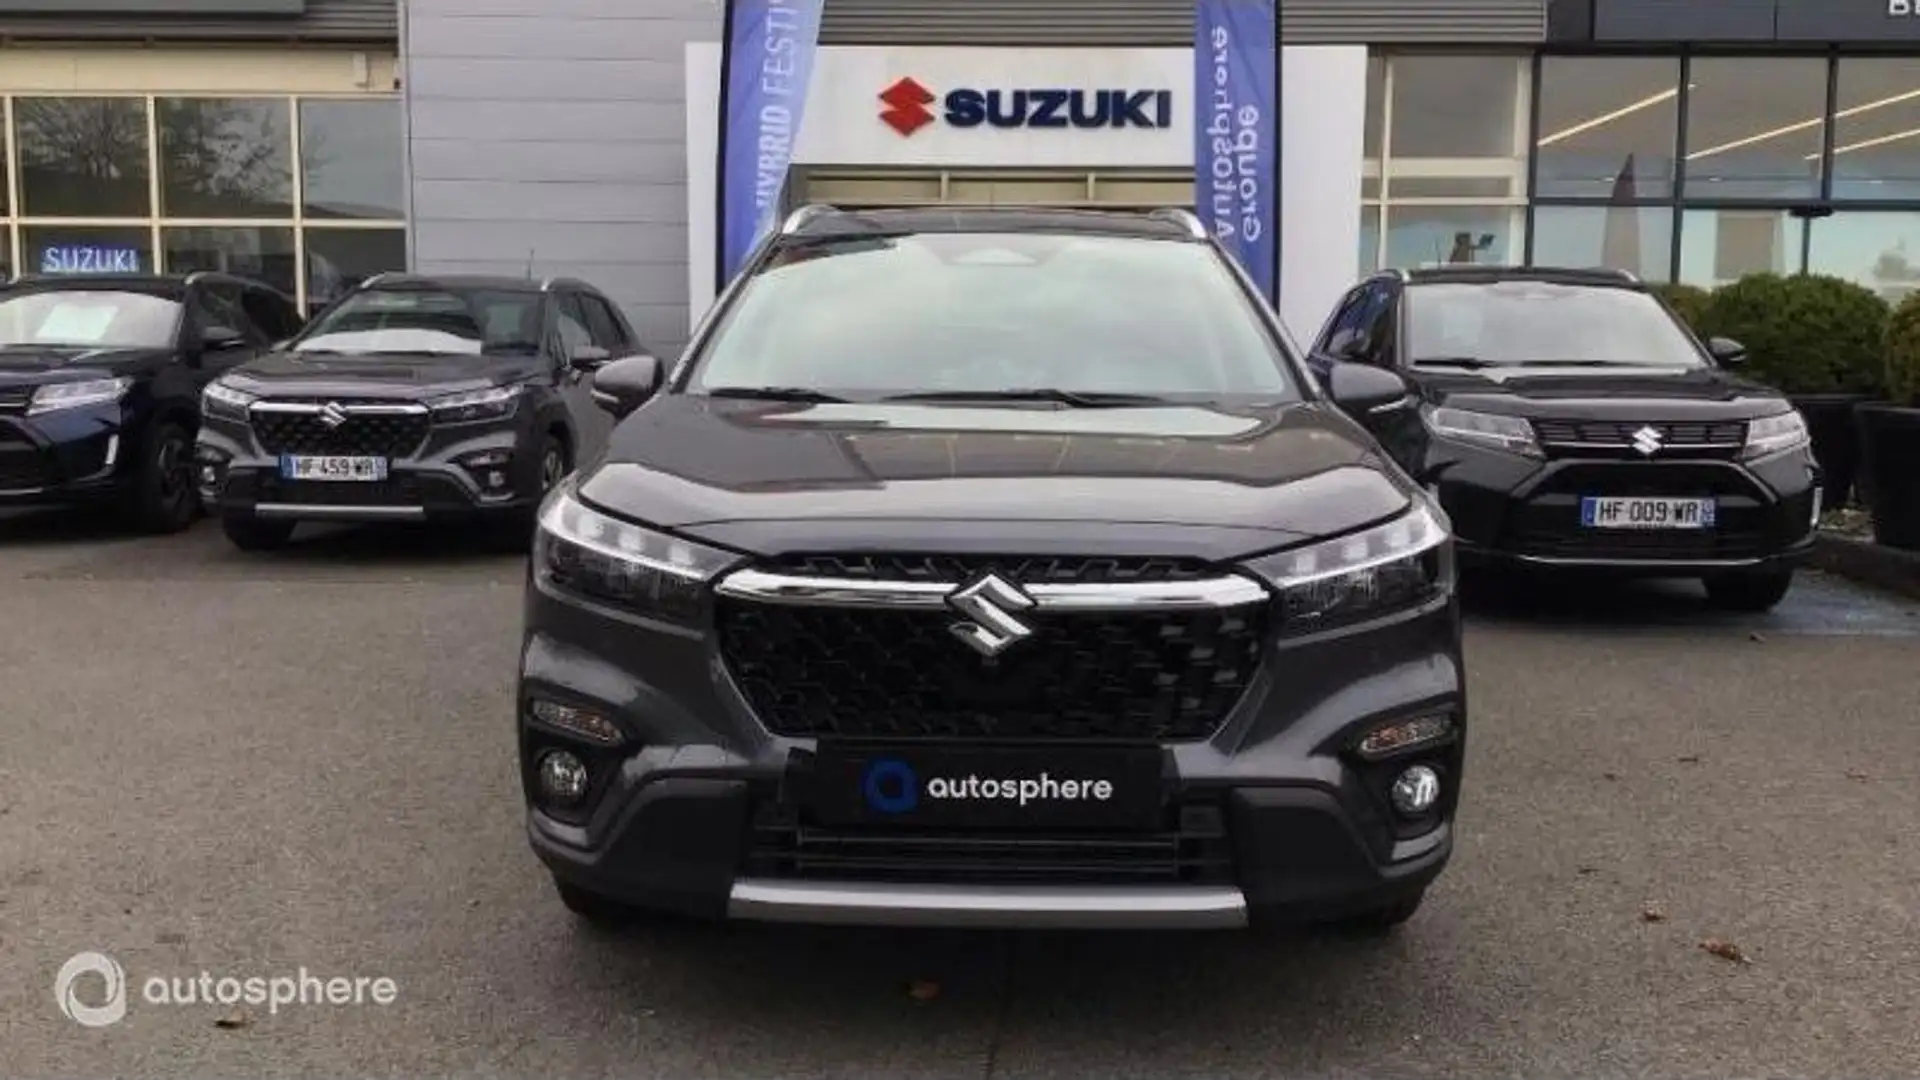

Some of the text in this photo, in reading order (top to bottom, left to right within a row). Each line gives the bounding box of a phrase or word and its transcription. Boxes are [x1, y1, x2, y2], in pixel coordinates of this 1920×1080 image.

[1889, 0, 1920, 15] B
[762, 0, 799, 96] FESTI
[944, 88, 1172, 129] SUZUKI
[42, 247, 137, 273] SUZUKI
[927, 772, 1113, 807] autosphere
